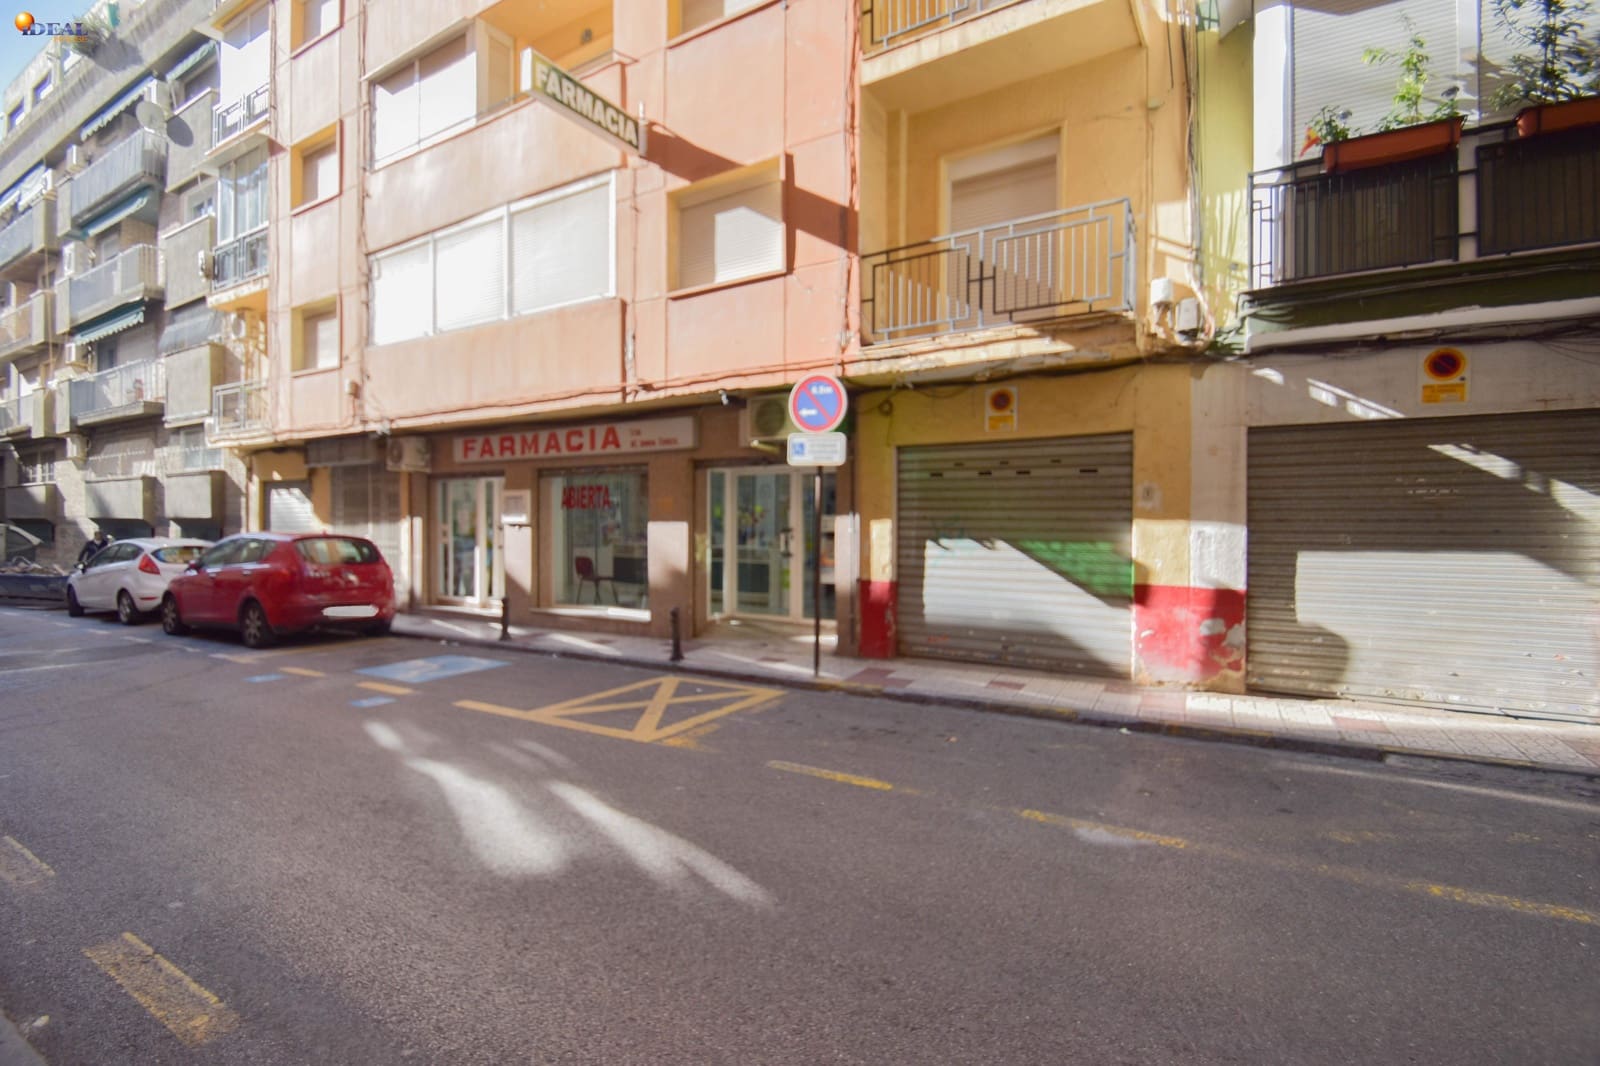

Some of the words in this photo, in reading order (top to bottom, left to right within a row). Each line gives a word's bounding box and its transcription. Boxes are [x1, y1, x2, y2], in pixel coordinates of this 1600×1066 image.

[535, 63, 638, 147] FARMACIA
[463, 426, 621, 459] FARMACIA
[561, 484, 612, 510] ABIERTA
